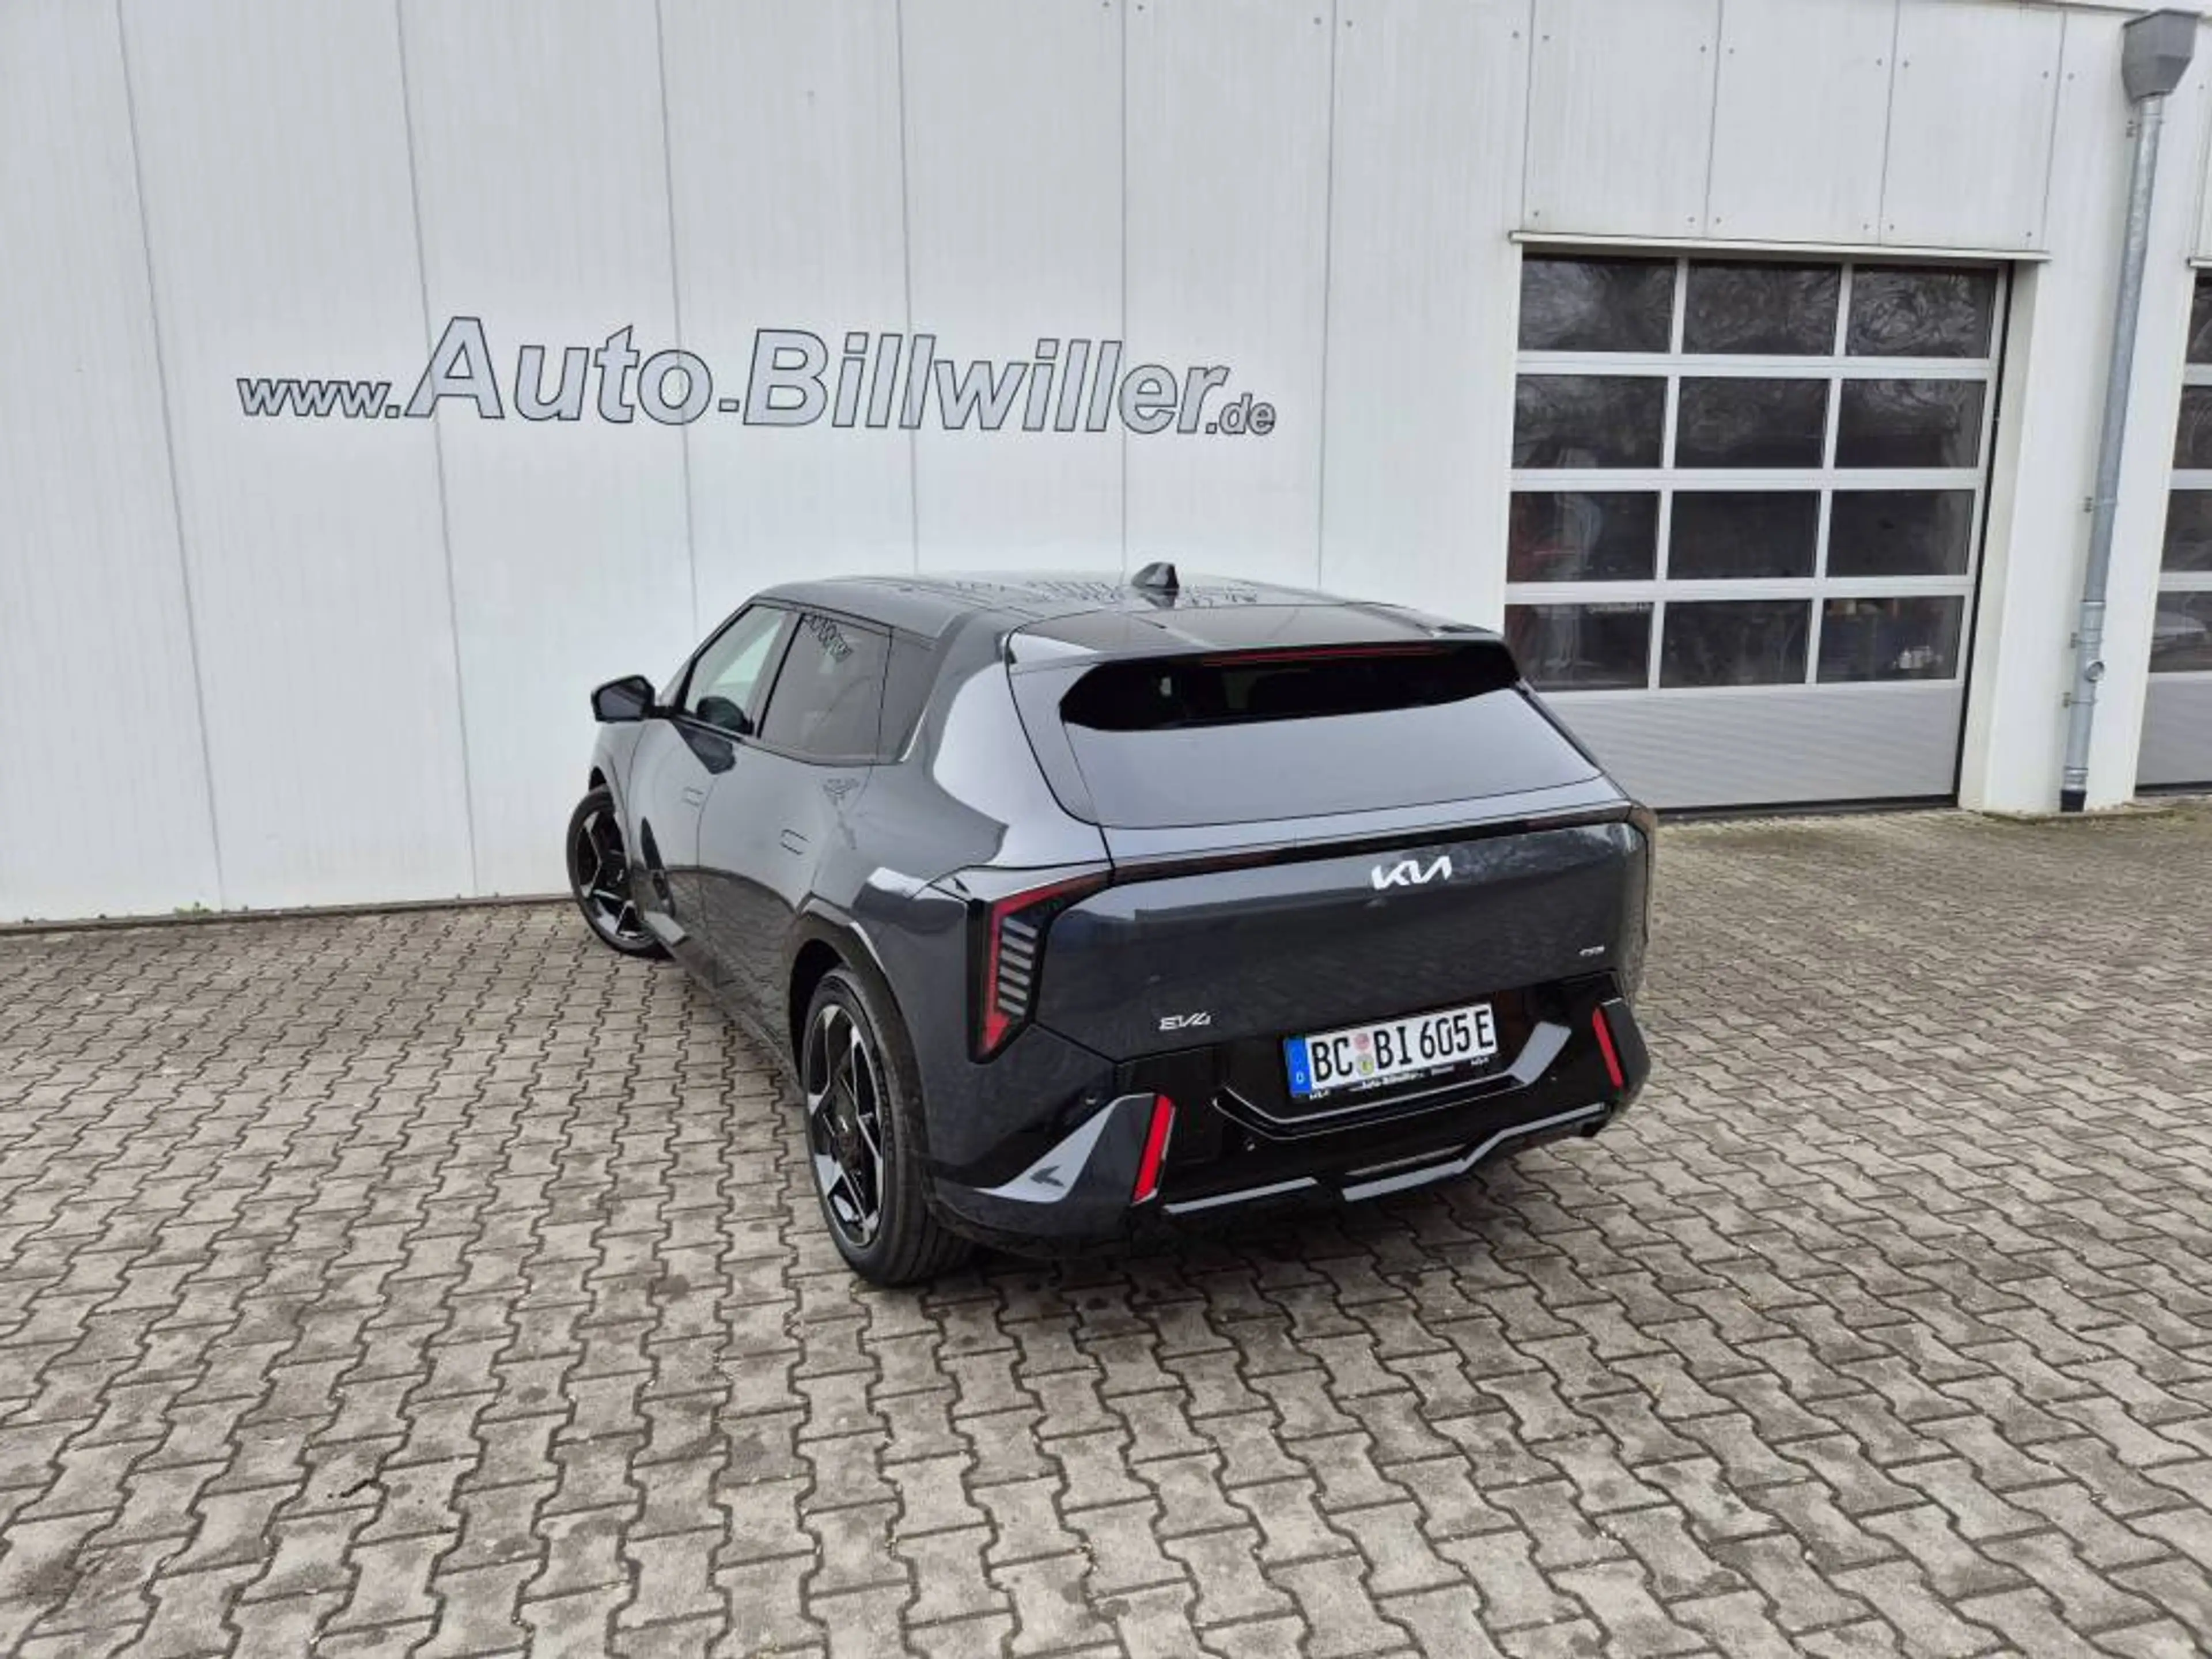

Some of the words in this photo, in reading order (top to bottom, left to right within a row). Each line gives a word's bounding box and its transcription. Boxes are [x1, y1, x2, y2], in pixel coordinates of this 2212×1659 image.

[237, 316, 1276, 435] www.Auto-Billwiller.de
[1158, 1012, 1211, 1032] EV4
[1311, 1037, 1353, 1082] BC
[1373, 1025, 1412, 1070] BI
